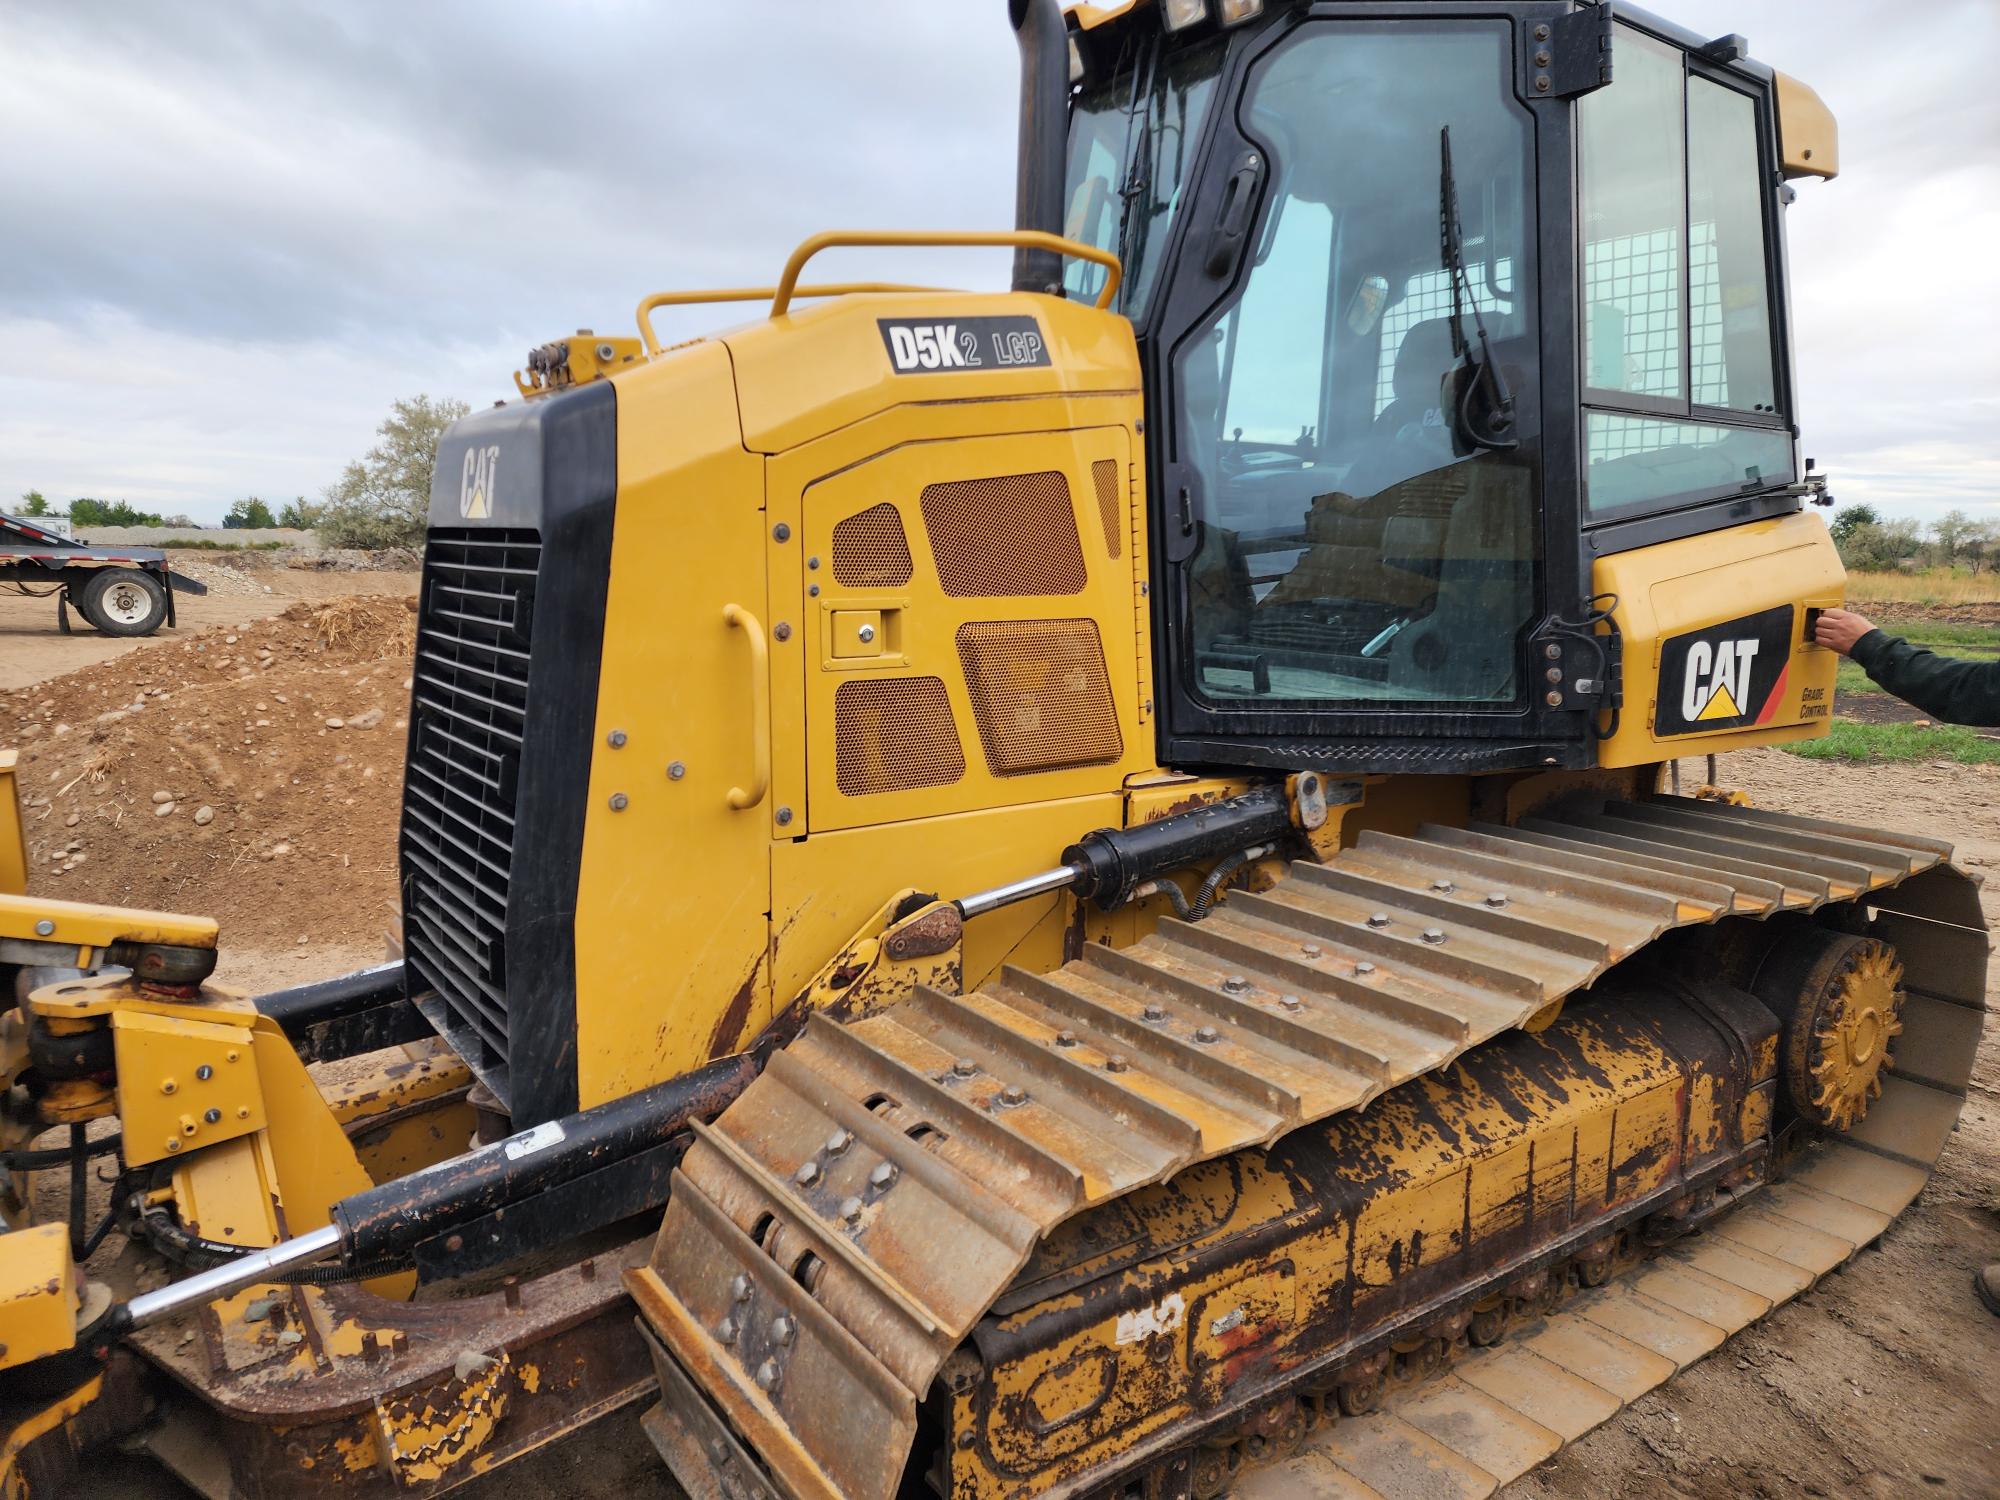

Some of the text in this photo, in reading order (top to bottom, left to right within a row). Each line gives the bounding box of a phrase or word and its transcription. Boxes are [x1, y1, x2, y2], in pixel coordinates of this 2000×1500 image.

[992, 332, 1042, 365] LGP
[1423, 407, 1444, 427] CA
[460, 446, 500, 518] CAT
[1682, 639, 1760, 722] CAT
